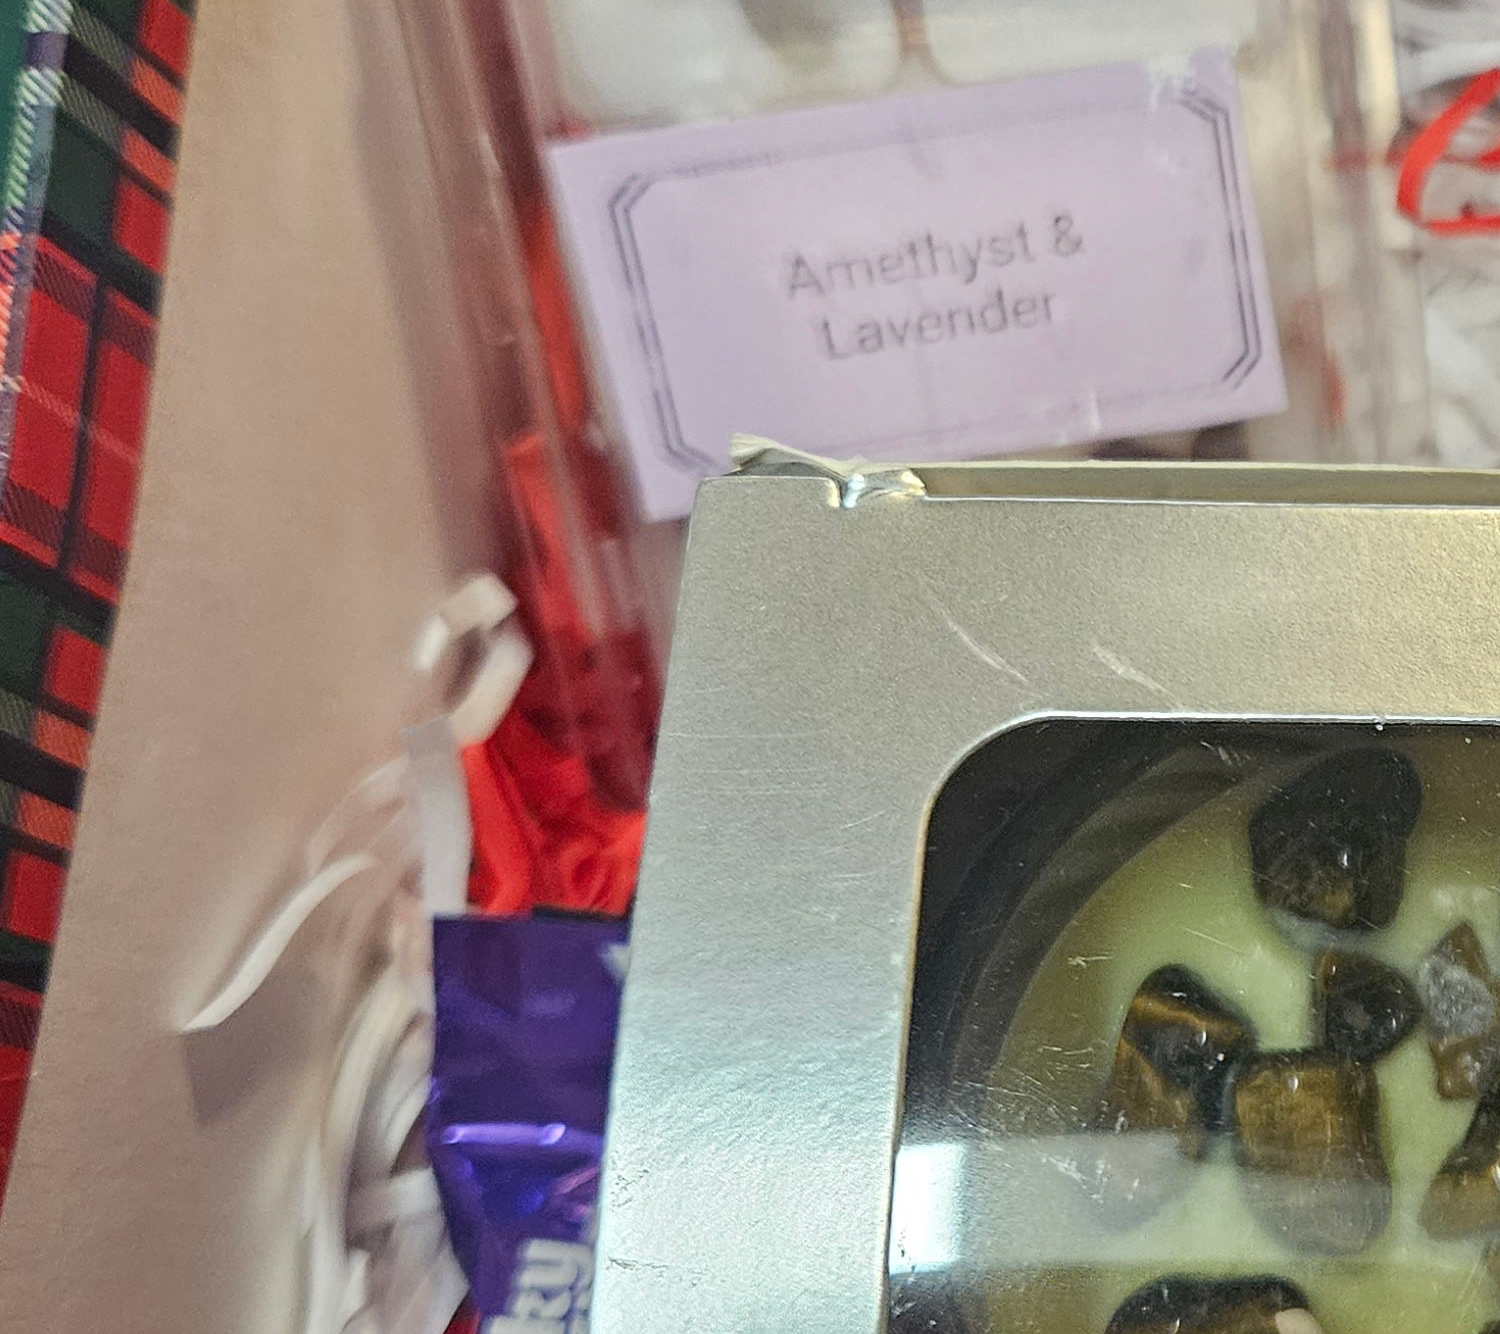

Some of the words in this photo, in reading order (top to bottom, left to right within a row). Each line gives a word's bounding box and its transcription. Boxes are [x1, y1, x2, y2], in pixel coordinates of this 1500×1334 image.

[787, 221, 1034, 298] Amethyst
[1051, 211, 1086, 259] &
[820, 288, 1056, 360] Lavender
